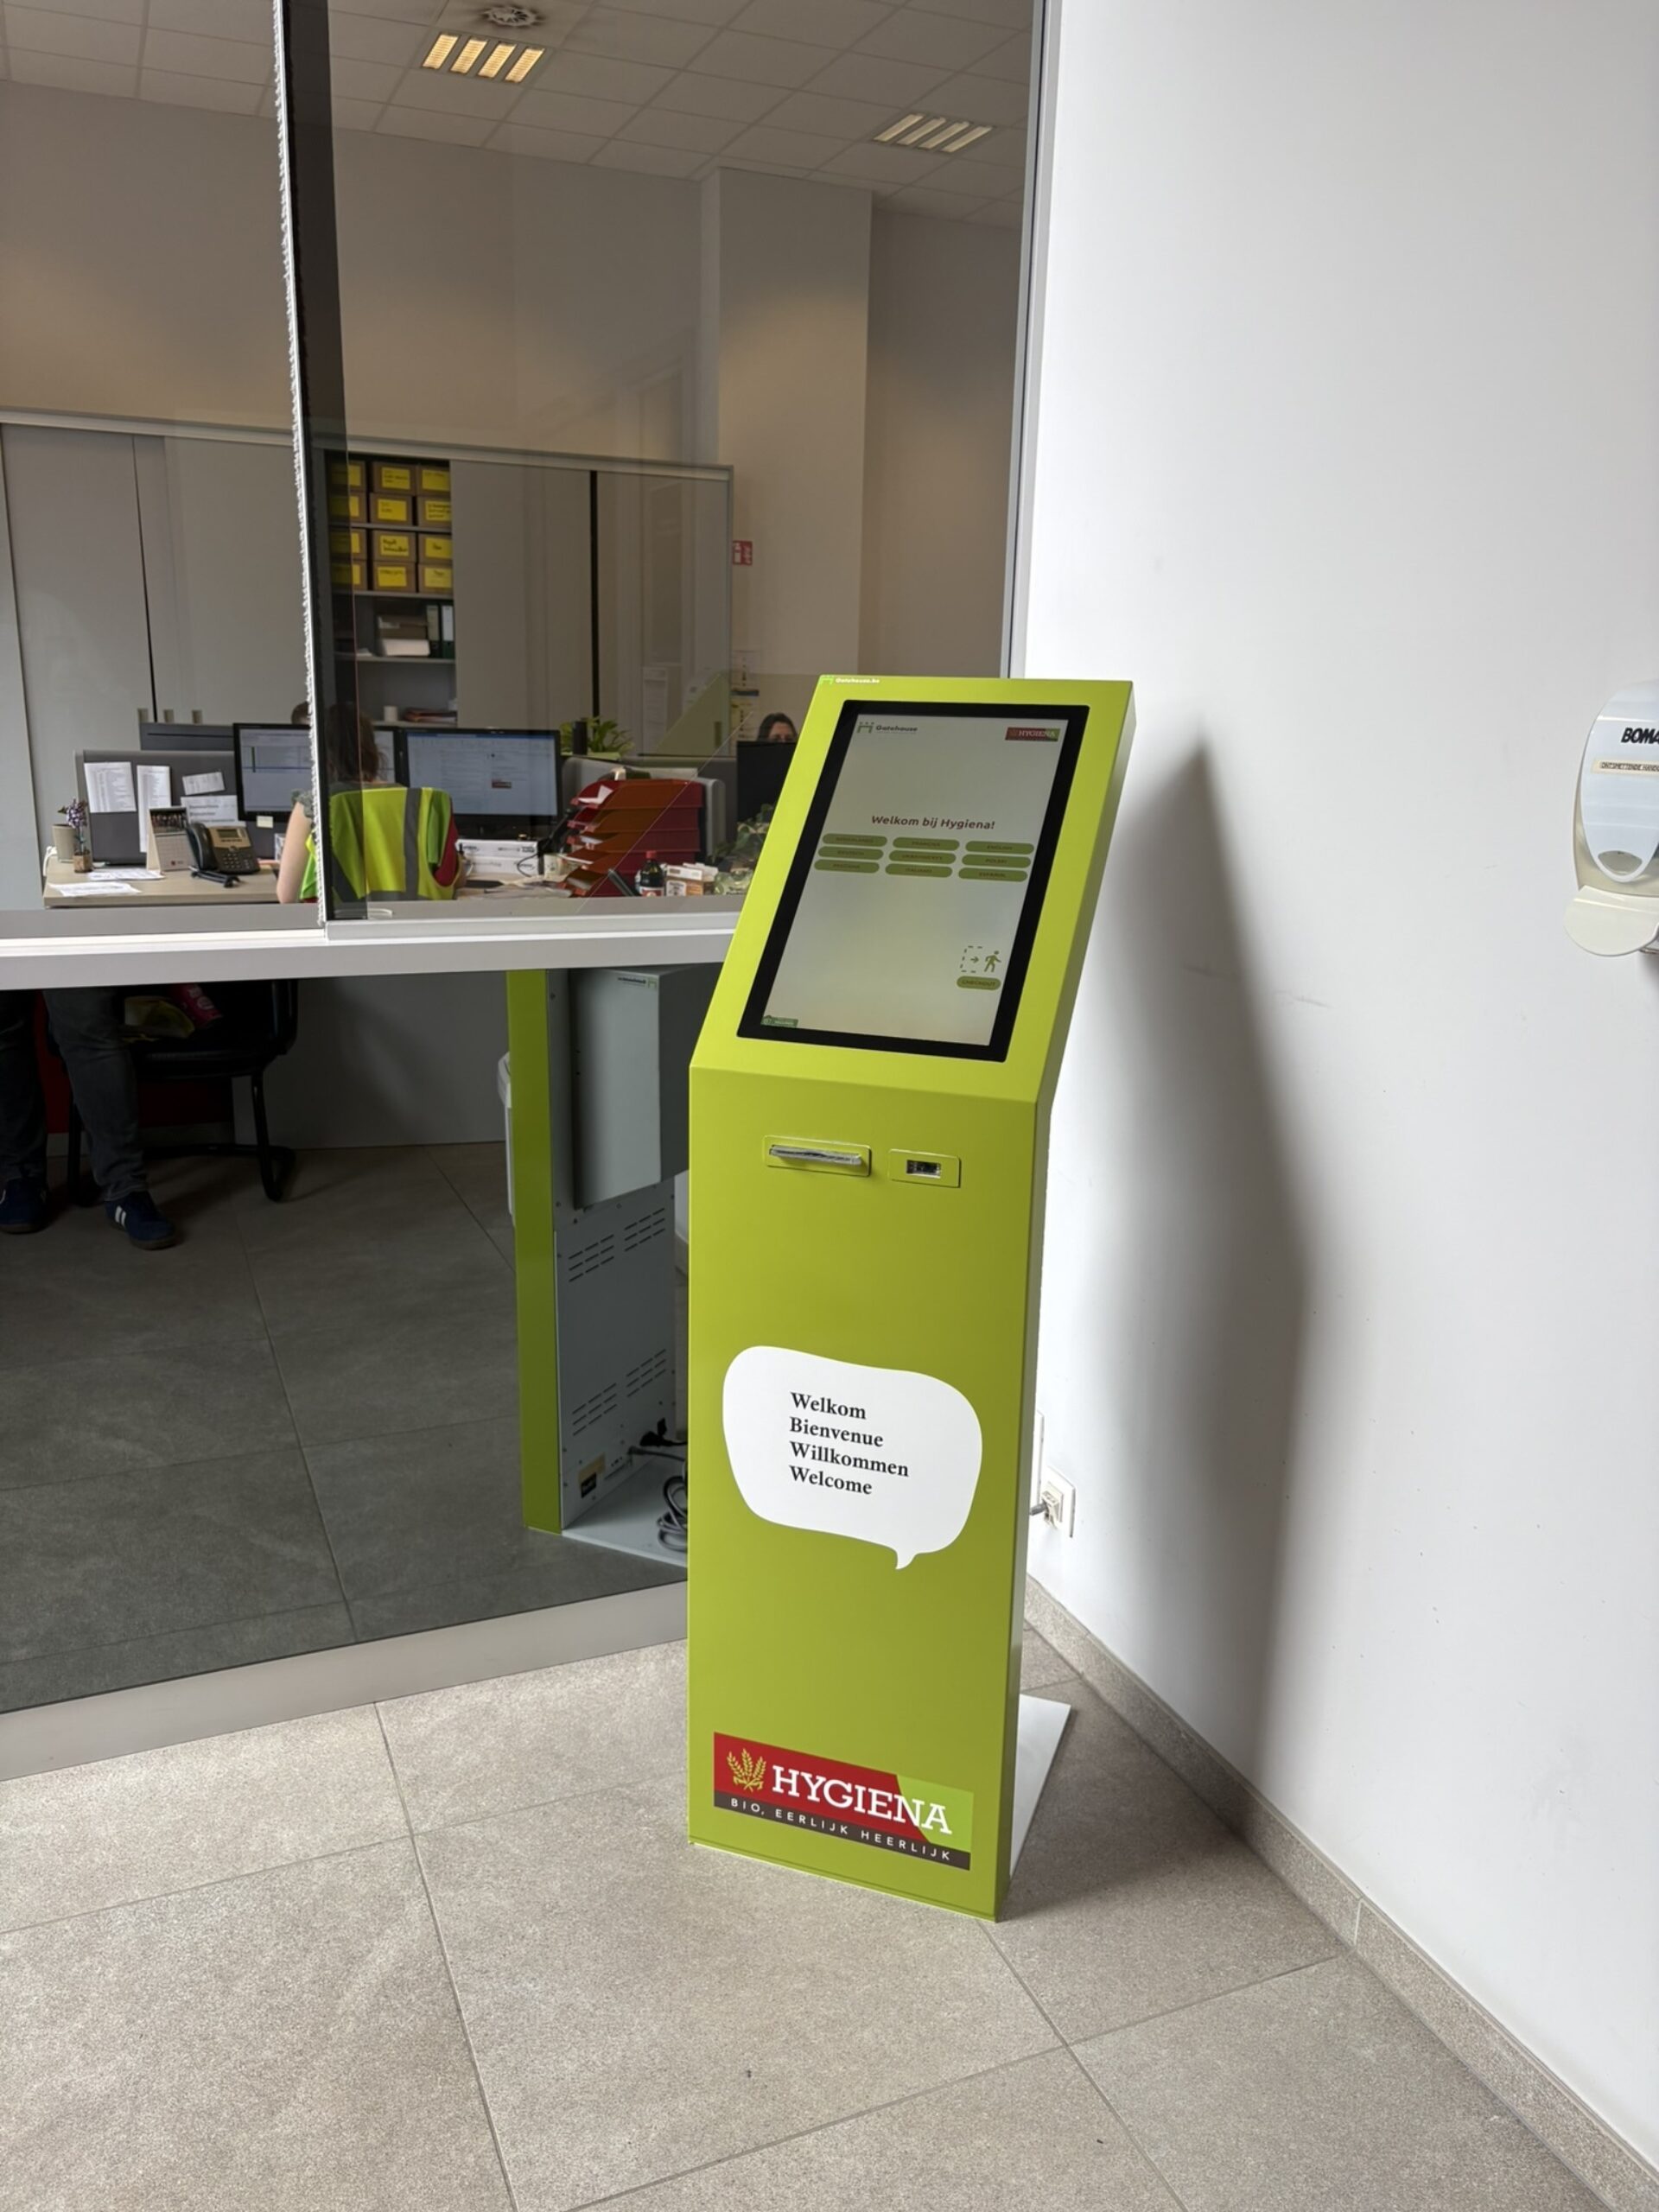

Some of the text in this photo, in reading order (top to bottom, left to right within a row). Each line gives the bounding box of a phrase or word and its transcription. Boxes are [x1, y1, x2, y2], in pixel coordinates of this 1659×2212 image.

[871, 815, 995, 830] Welkom bij Hygiena!
[790, 1392, 867, 1420] Welkom
[790, 1416, 884, 1447] Bienvenue
[789, 1440, 910, 1478] Willkommen
[789, 1465, 873, 1495] Welcome
[772, 1765, 952, 1834] HYGIENA
[730, 1798, 950, 1860] BIO, EERLIJK HEERLIJK
